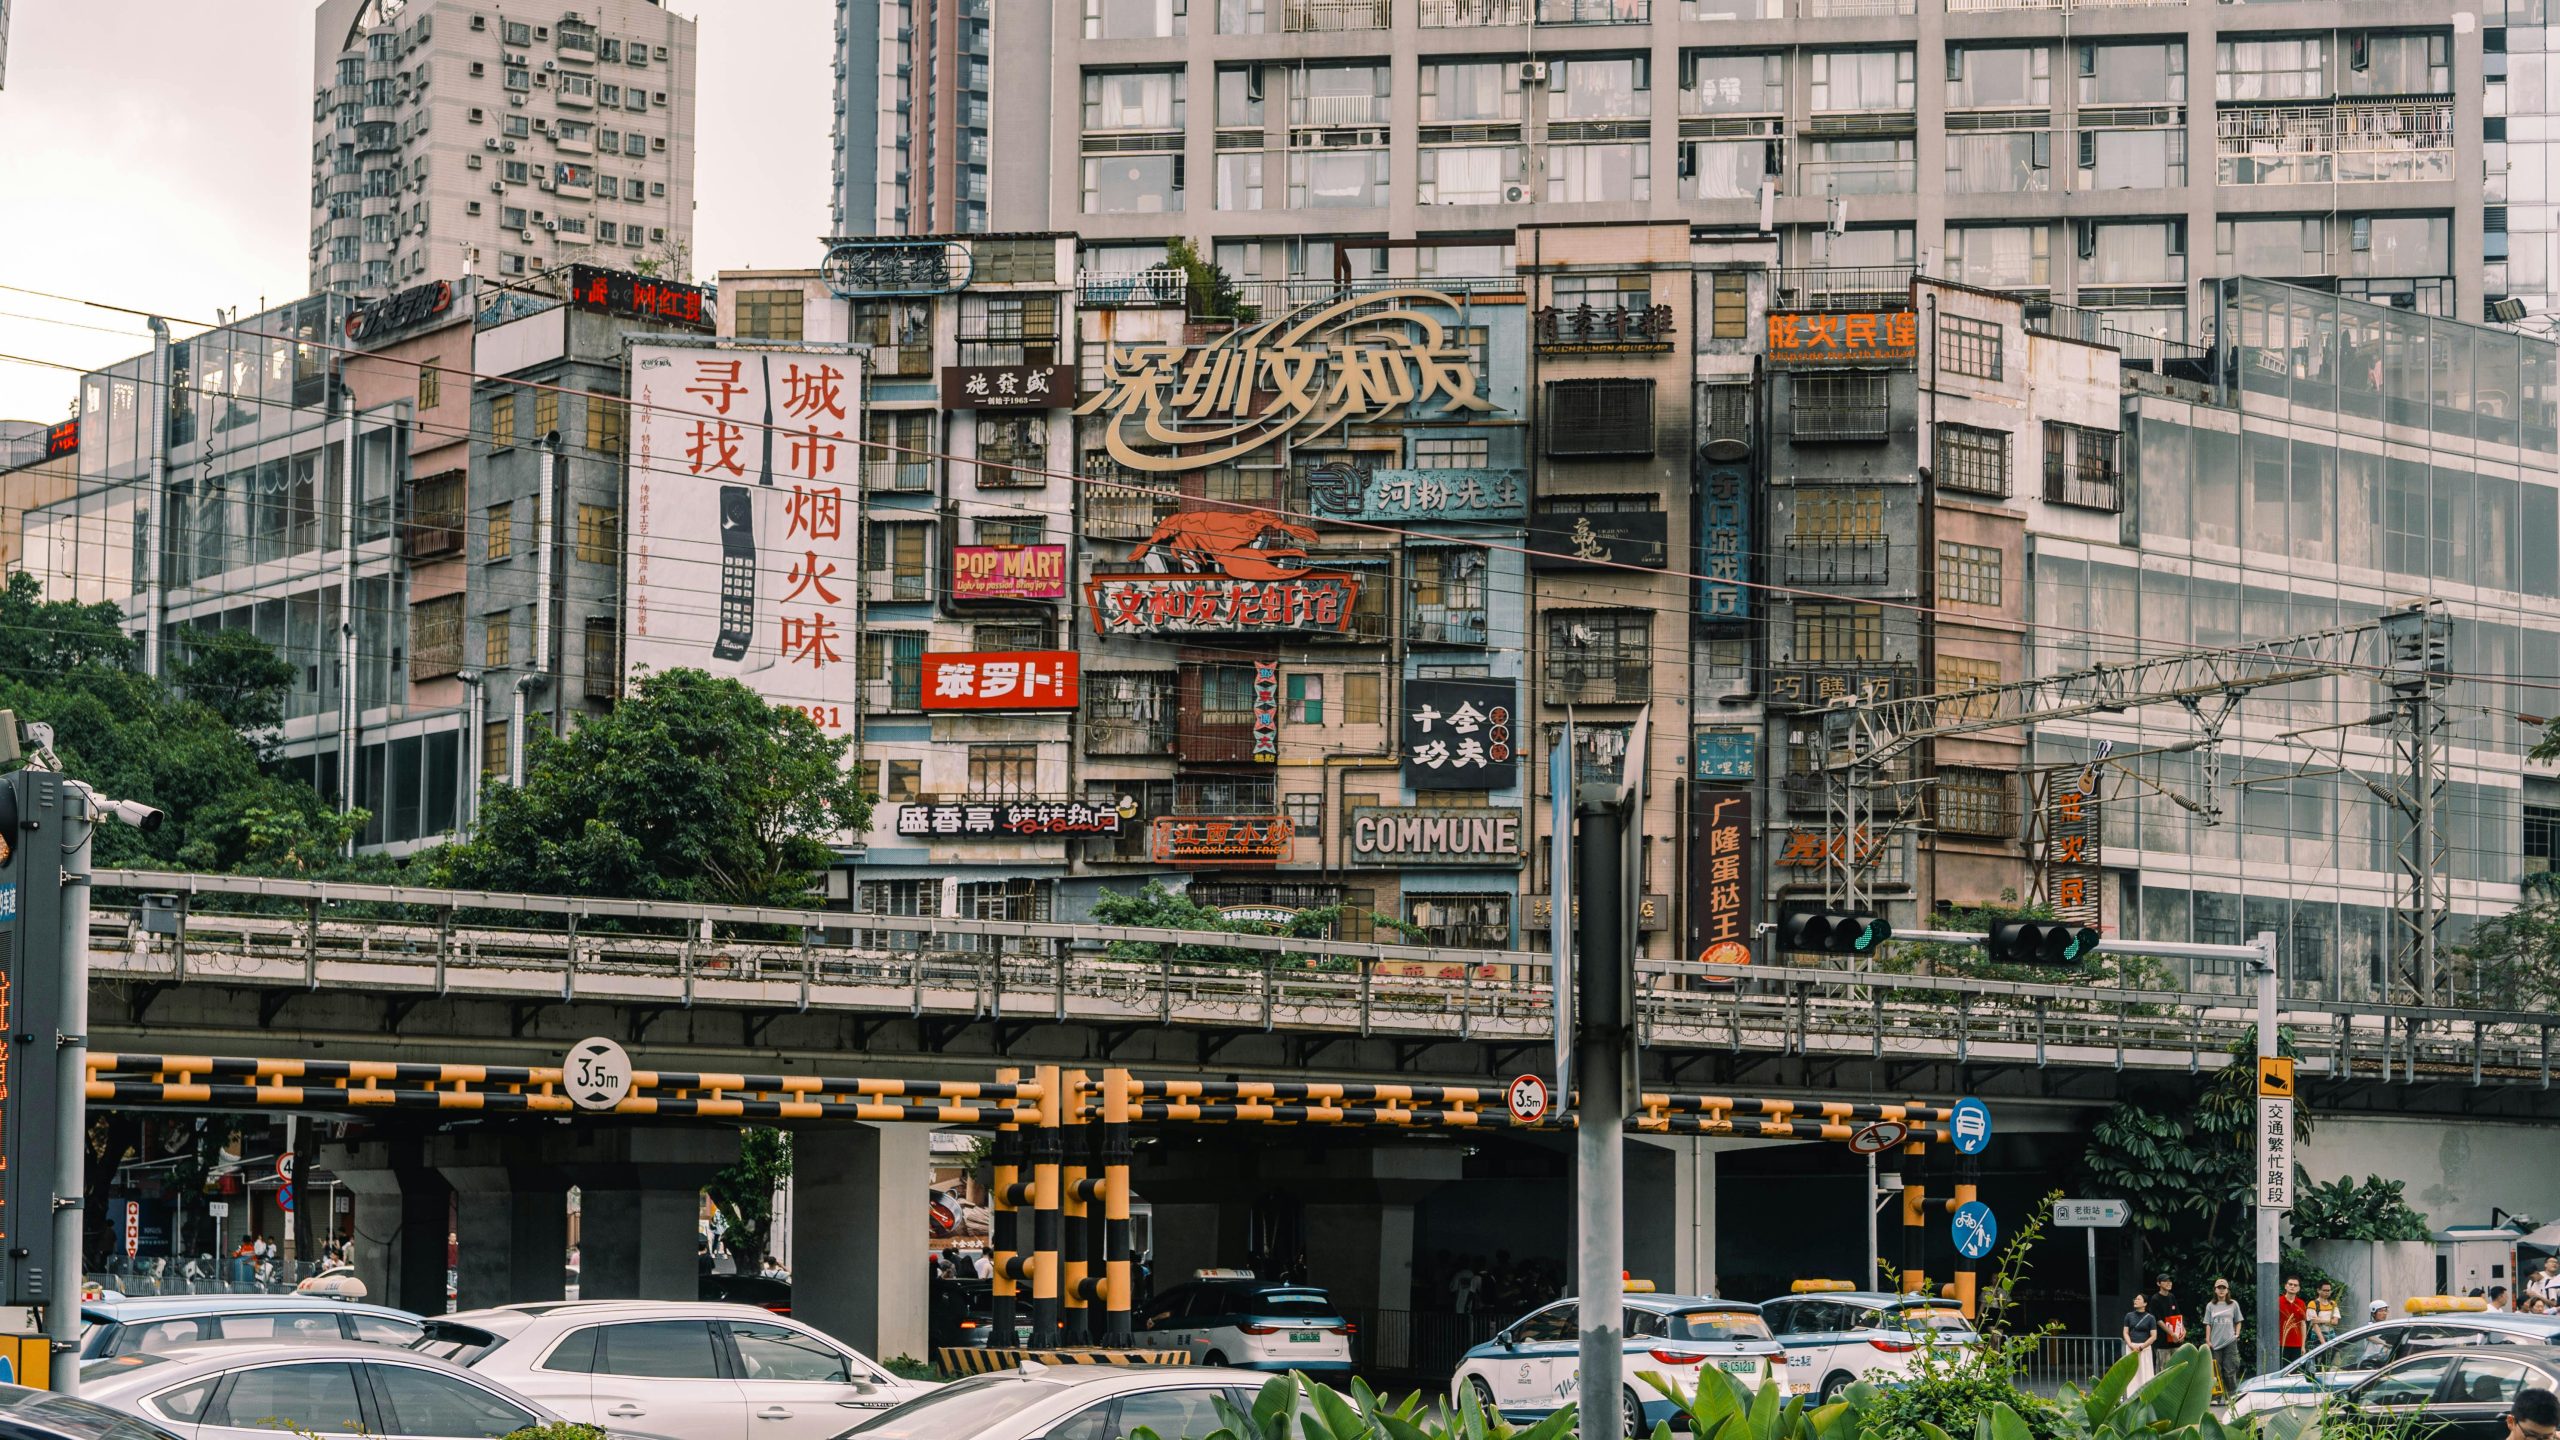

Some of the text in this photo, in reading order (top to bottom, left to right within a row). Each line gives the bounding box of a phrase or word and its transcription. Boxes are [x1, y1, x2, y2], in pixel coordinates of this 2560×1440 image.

[685, 360, 749, 477] 寻找
[1378, 477, 1524, 512] 河粉先生
[780, 364, 846, 670] 城市烟火味
[955, 551, 1062, 579] POP MART
[1110, 584, 1339, 626] 文和友龙虾馆
[935, 661, 1051, 699] 笨罗卜
[899, 806, 994, 833] 盛香亭
[1174, 821, 1291, 846] 江西小炒
[1355, 816, 1519, 854] COMMUNE
[1711, 798, 1741, 942] 广隆蛋挞王
[577, 1058, 619, 1089] 3.5m
[1516, 1089, 1541, 1108] 3.5m
[2267, 1103, 2284, 1203] 交通繁忙路段
[2074, 1206, 2100, 1215] 老街站
[1730, 1361, 1755, 1373] C51217
